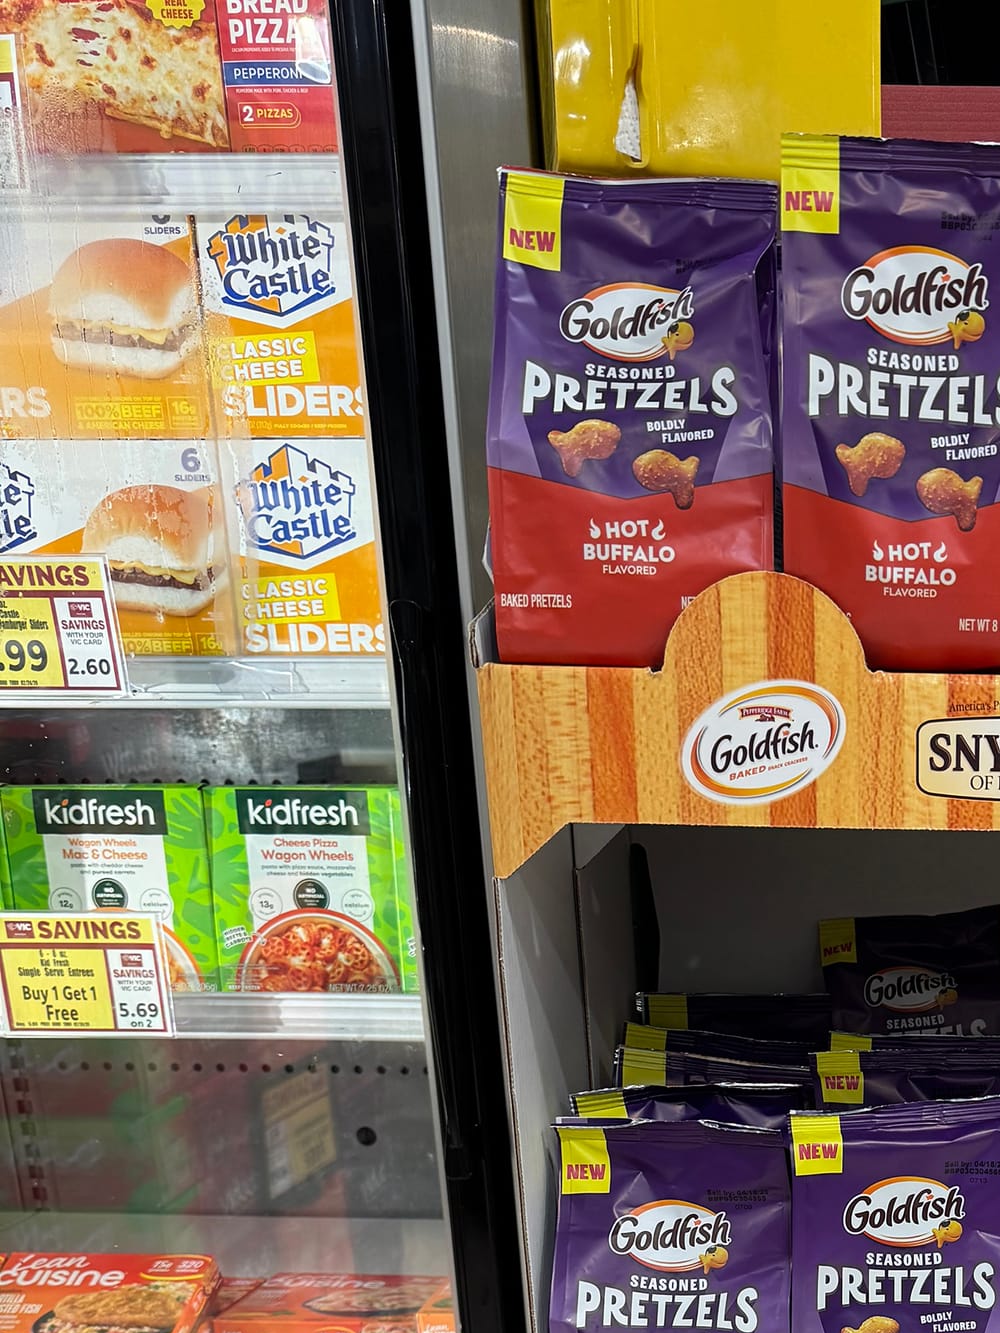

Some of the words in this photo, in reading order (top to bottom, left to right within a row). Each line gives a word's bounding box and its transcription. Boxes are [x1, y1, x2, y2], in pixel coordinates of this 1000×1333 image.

[161, 9, 194, 19] CHEESE
[242, 106, 254, 121] 2
[257, 110, 293, 119] PIZZAS
[786, 191, 834, 213] NEW
[144, 226, 181, 236] SLIDERS
[509, 228, 556, 253] NEW
[223, 230, 321, 269] White
[223, 264, 330, 300] Castle
[843, 264, 989, 321] Goldfish
[562, 288, 695, 341] Goldfish
[218, 338, 307, 359] CLASSIC
[867, 348, 960, 371] SEASONED
[584, 363, 675, 379] SEASONED
[522, 360, 739, 415] PRETZELS
[122, 404, 161, 418] BEEF
[646, 419, 686, 434] BOLDLY
[661, 428, 714, 445] FLAVORED
[931, 434, 970, 449] BOLDLY
[181, 448, 201, 473] 6
[606, 520, 650, 539] HOT
[582, 544, 676, 563] BUFFALO
[889, 542, 931, 562] HOT
[602, 565, 657, 576] FLAVORED
[864, 565, 957, 586] BUFFALO
[501, 594, 528, 608] BAKED
[530, 595, 572, 609] PRETZELS
[62, 620, 105, 630] SAVINGS
[959, 618, 976, 632] NET
[977, 619, 990, 633] WT
[992, 619, 998, 633] 8
[69, 659, 110, 675] 2.60
[711, 721, 814, 773] Goldfish
[970, 776, 995, 791] OF
[44, 799, 156, 825] kidfresh
[247, 799, 359, 826] kidfresh
[273, 838, 310, 847] Cheese
[313, 839, 338, 847] Pizza
[63, 849, 88, 860] Mac
[92, 849, 99, 859] &
[102, 849, 148, 860] Cheese
[261, 849, 306, 863] Wagon
[310, 850, 354, 861] Wheels
[38, 921, 141, 939] SAVINGS
[113, 969, 155, 978] SAVINGS
[22, 986, 48, 1005] Buy
[52, 987, 58, 1000] 1
[63, 986, 87, 1001] Get
[91, 987, 97, 1000] 1
[46, 1005, 78, 1021] Free
[119, 1003, 158, 1017] 5.69
[844, 1187, 965, 1235] Goldfish
[610, 1213, 732, 1257] Goldfish
[13, 1254, 89, 1275] Lean
[816, 1262, 996, 1311] PRETZELS
[576, 1280, 759, 1333] PRETZELS
